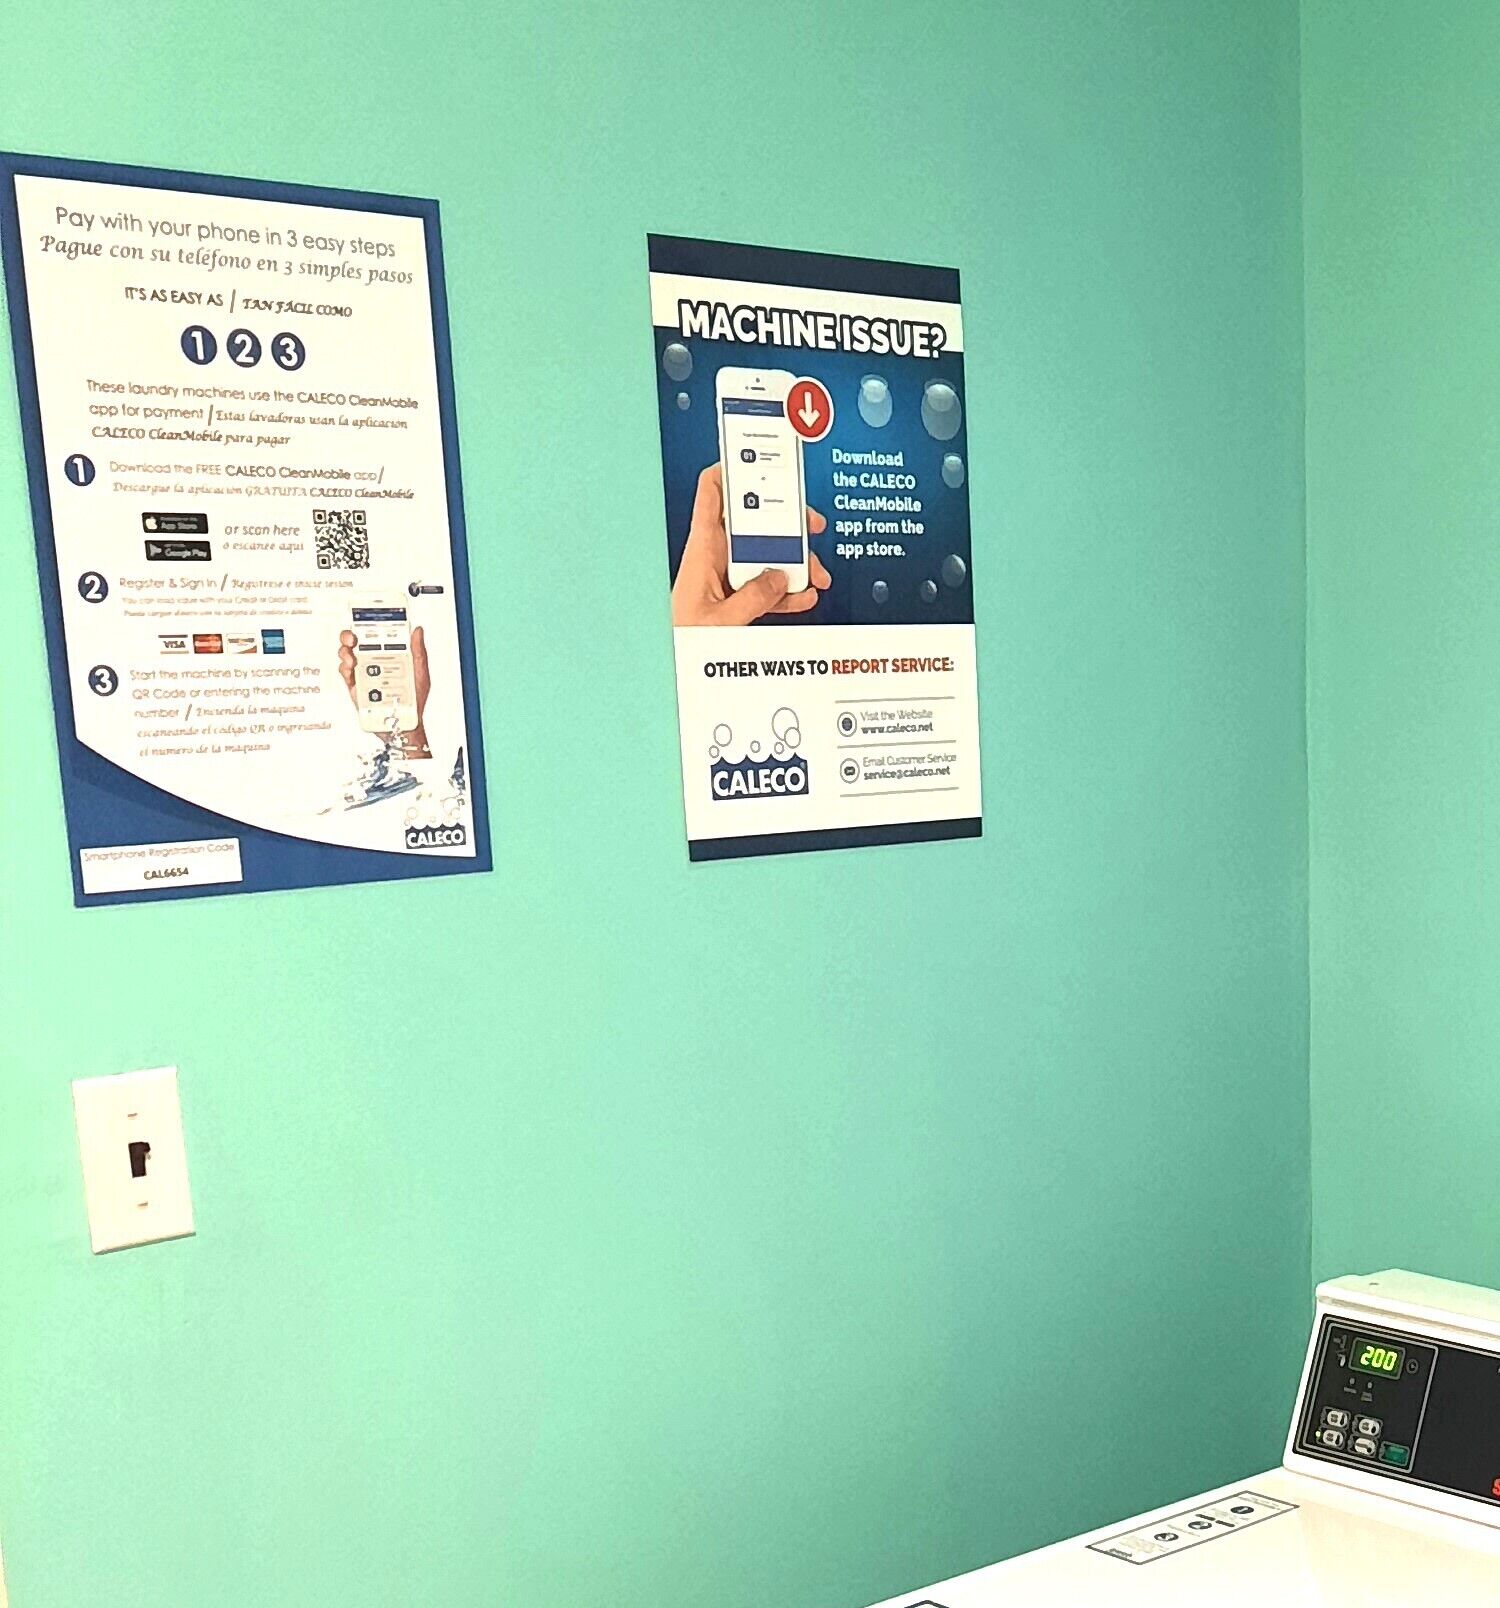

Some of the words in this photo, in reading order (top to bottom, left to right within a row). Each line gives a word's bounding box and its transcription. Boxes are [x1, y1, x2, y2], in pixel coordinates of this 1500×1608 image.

[56, 206, 94, 232] Pay
[100, 212, 143, 232] with
[148, 220, 192, 238] your
[197, 222, 260, 244] phone
[266, 227, 282, 245] in
[287, 230, 298, 248] 3
[303, 235, 344, 256] easy
[350, 237, 396, 259] steps
[40, 235, 103, 261] Pague
[110, 245, 144, 259] con
[150, 249, 170, 262] su
[178, 247, 251, 272] teléfono
[257, 259, 278, 272] en
[283, 261, 293, 276] 3
[299, 260, 362, 283] simples
[364, 269, 413, 287] pasos
[125, 287, 147, 301] IT'S
[150, 289, 167, 302] AS
[171, 290, 202, 305] EASY
[207, 293, 224, 306] AS
[242, 298, 274, 312] TAN
[316, 304, 353, 318] COMO
[678, 299, 838, 352] MACHINE
[838, 314, 947, 359] ISSUE?
[191, 330, 205, 361] 1
[234, 333, 255, 363] 2
[279, 337, 299, 367] 3
[87, 379, 125, 394] These
[128, 382, 178, 398] laundry
[183, 386, 245, 400] machines
[249, 391, 270, 401] use
[274, 390, 294, 402] the
[297, 391, 346, 406] CALECO
[349, 394, 419, 409] CleanMobile
[89, 404, 119, 418] app
[121, 403, 140, 416] for
[143, 407, 204, 420] payment
[216, 410, 245, 422] Estas
[249, 409, 306, 425] lavadoras
[310, 416, 335, 426] usan
[338, 414, 349, 426] la
[92, 425, 146, 439] CALECO
[149, 428, 223, 442] CleanMobile
[224, 432, 253, 447] para
[256, 435, 291, 448] pagar
[832, 448, 904, 467] Download
[72, 457, 86, 483] 1
[110, 460, 171, 474] Download
[174, 464, 193, 475] the
[196, 464, 222, 475] FREE
[225, 464, 276, 478] CALECO
[279, 466, 351, 480] CleanMobile
[833, 471, 857, 488] the
[859, 472, 917, 490] CALECO
[310, 487, 352, 498] CALECO
[833, 494, 922, 513] CleanMobile
[224, 525, 240, 536] or
[243, 525, 270, 536] scan
[273, 524, 300, 536] here
[835, 519, 863, 538] app
[865, 517, 899, 535] from
[901, 518, 925, 536] the
[836, 543, 863, 560] app
[865, 541, 906, 557] store.
[84, 574, 103, 599] 2
[120, 577, 165, 590] Register
[169, 578, 178, 588] &
[180, 577, 205, 590] Sign
[163, 640, 186, 649] VISA
[704, 660, 760, 678] OTHER
[760, 659, 806, 677] WAYS
[807, 659, 829, 676] TO
[831, 657, 889, 675] REPORT
[891, 656, 955, 673] SERVICE:
[94, 668, 113, 693] 3
[130, 669, 155, 681] Start
[159, 670, 178, 680] the
[181, 669, 231, 679] machine
[234, 668, 247, 680] by
[251, 668, 300, 679] scanning
[303, 666, 320, 676] the
[132, 688, 149, 700] QR
[153, 688, 186, 699] Code
[190, 689, 201, 698] or
[203, 687, 250, 698] entering
[253, 686, 270, 696] the
[273, 685, 320, 695] machine
[134, 708, 179, 718] number
[860, 710, 880, 722] Visit
[880, 710, 896, 721] the
[896, 708, 933, 720] Website
[861, 721, 933, 734] www.caleco.net
[863, 756, 886, 768] Email
[886, 755, 926, 766] Customer
[927, 753, 957, 764] Service
[713, 766, 806, 797] CALECO
[864, 765, 950, 781] service@caleco.net
[407, 829, 464, 847] CALECO
[85, 851, 147, 863] Smartphone
[149, 846, 205, 859] Registration
[207, 843, 235, 854] Code
[1360, 1345, 1398, 1371] 200
